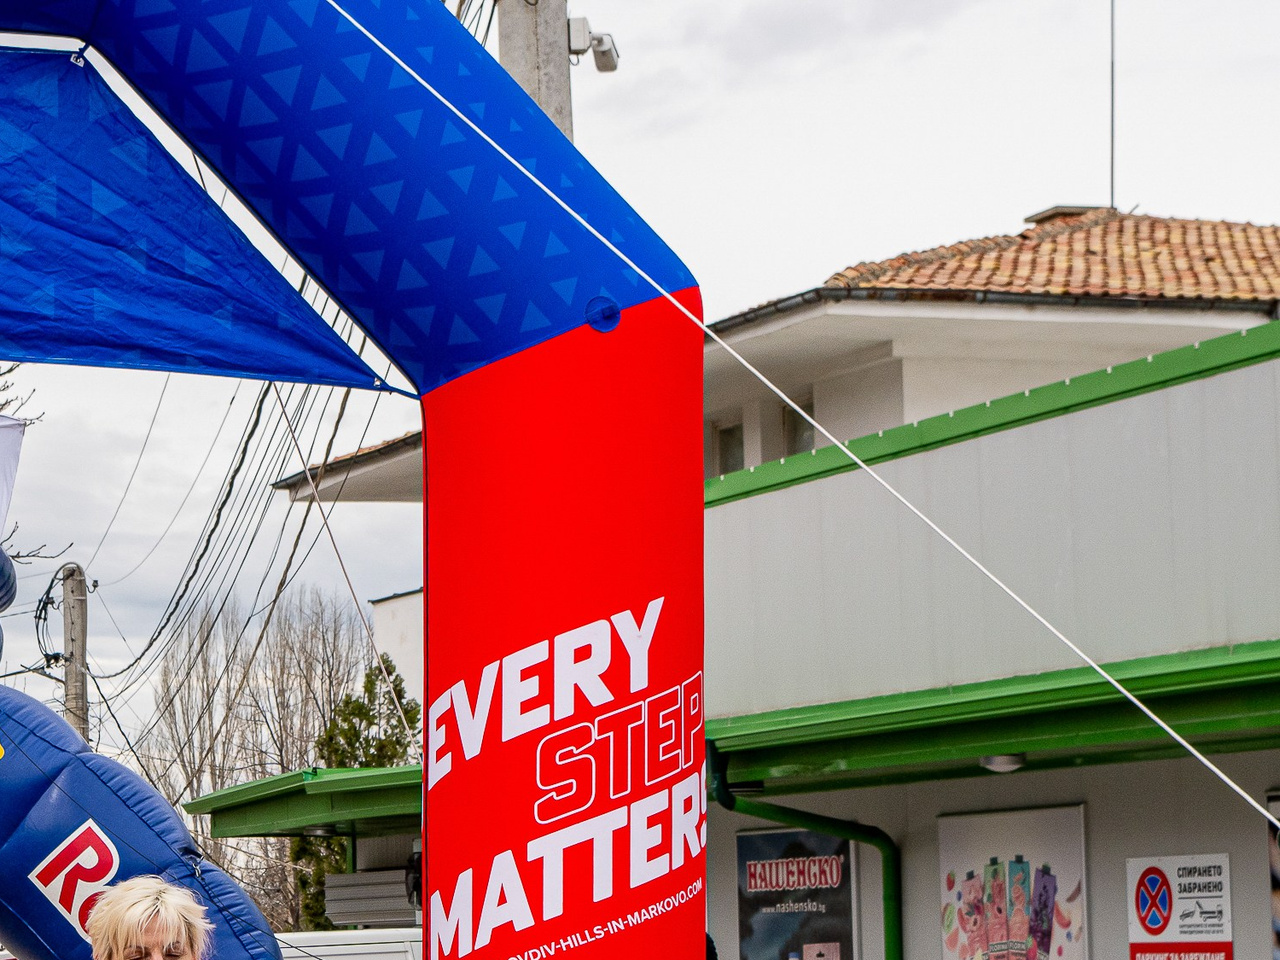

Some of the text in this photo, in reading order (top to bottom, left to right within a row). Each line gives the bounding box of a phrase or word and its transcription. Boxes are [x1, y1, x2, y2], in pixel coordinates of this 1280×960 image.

[428, 597, 664, 791] EVERY
[534, 671, 703, 824] STEP
[746, 856, 842, 892] НАШЕНСКО
[1177, 865, 1222, 879] СПИРАНЕТО
[1177, 881, 1223, 894] ЗАБРАНЕНО
